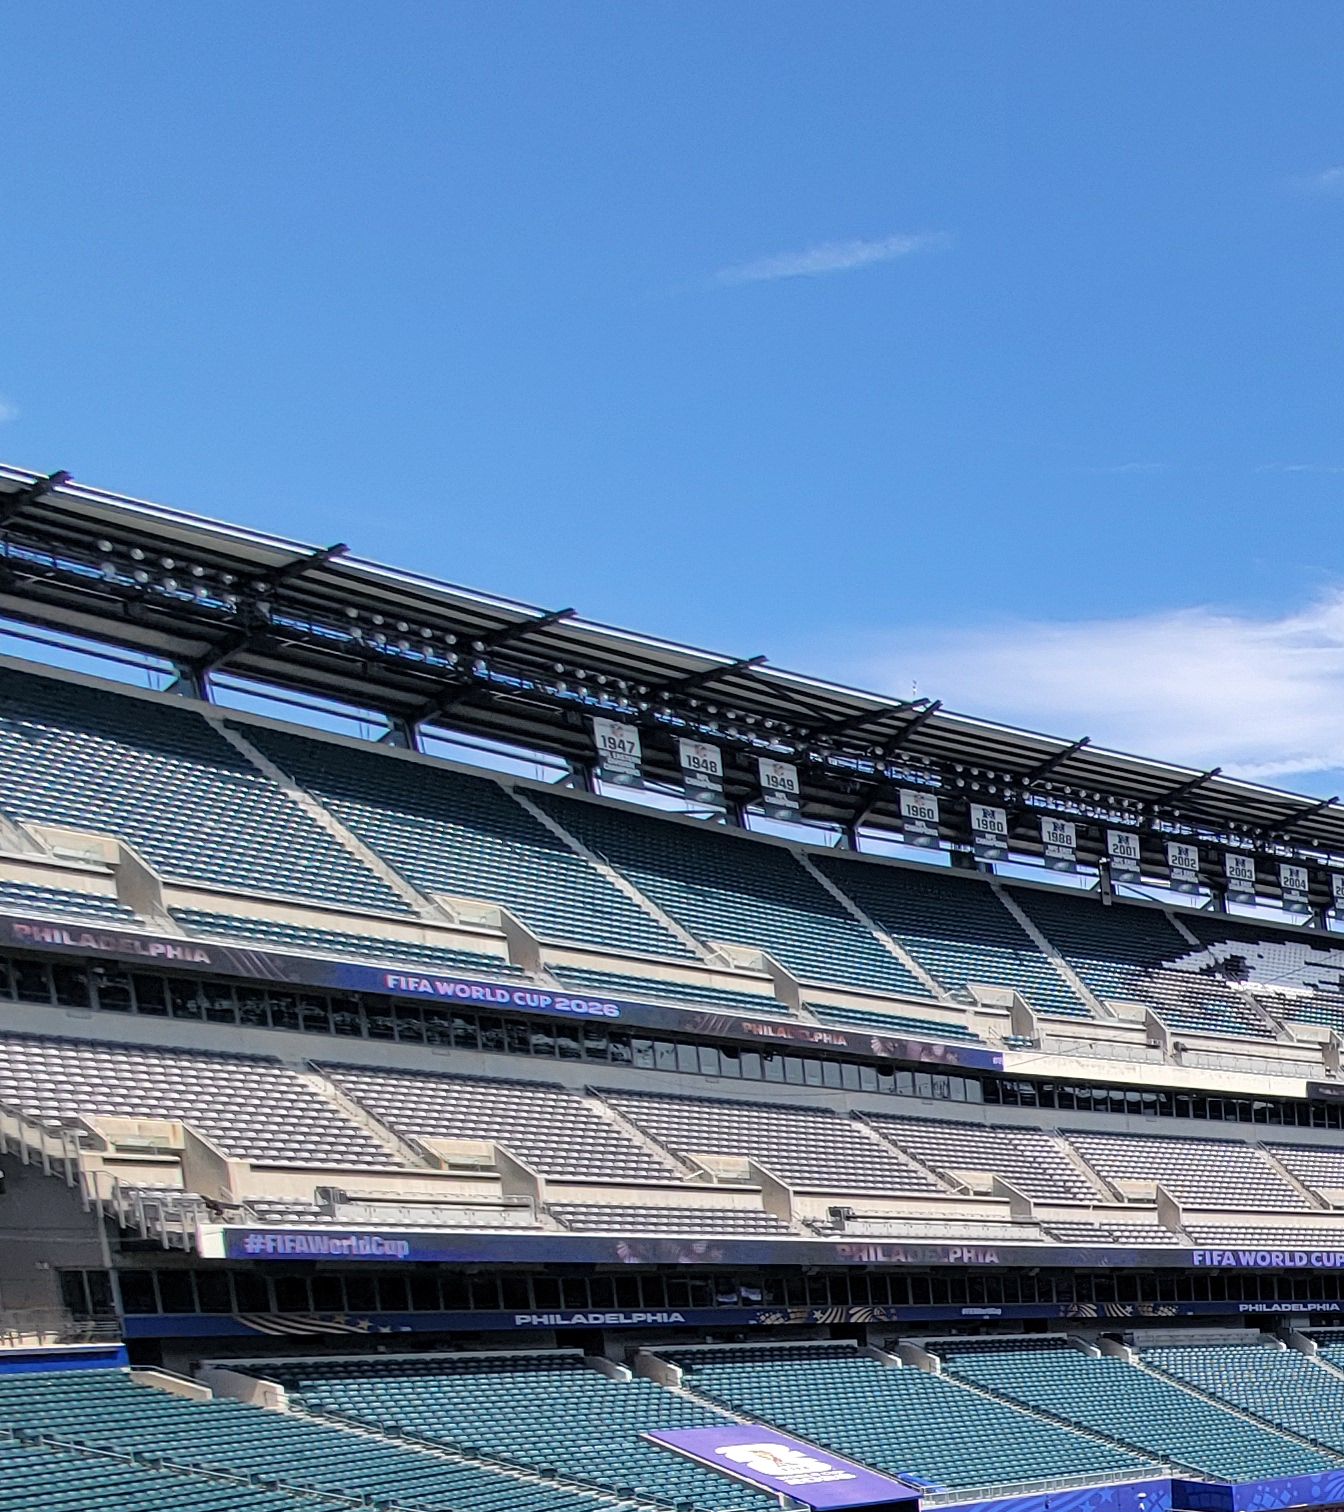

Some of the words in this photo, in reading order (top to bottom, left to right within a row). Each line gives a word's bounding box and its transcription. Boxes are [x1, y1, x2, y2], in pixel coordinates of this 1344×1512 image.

[600, 734, 635, 754] 1947
[685, 754, 717, 773] 1948
[764, 773, 795, 792] 1949
[906, 803, 934, 820] 1960
[975, 817, 1004, 833] 1980
[1112, 843, 1137, 858] 2001
[1171, 855, 1196, 869] 2002
[1228, 866, 1253, 879] 2003
[1283, 877, 1306, 890] 2004
[13, 923, 212, 964] PHILADELPHIA
[386, 974, 434, 994] FIFA
[436, 981, 510, 1004] WORLD
[513, 991, 552, 1009] CUP
[554, 997, 621, 1018] 2026
[244, 1234, 409, 1257] #FIFAWorldCup
[1193, 1250, 1236, 1267] FIFA
[1237, 1251, 1308, 1267] WORLD
[1239, 1302, 1341, 1313] PHILADELPHIA
[514, 1311, 685, 1325] PHILADELPHIA
